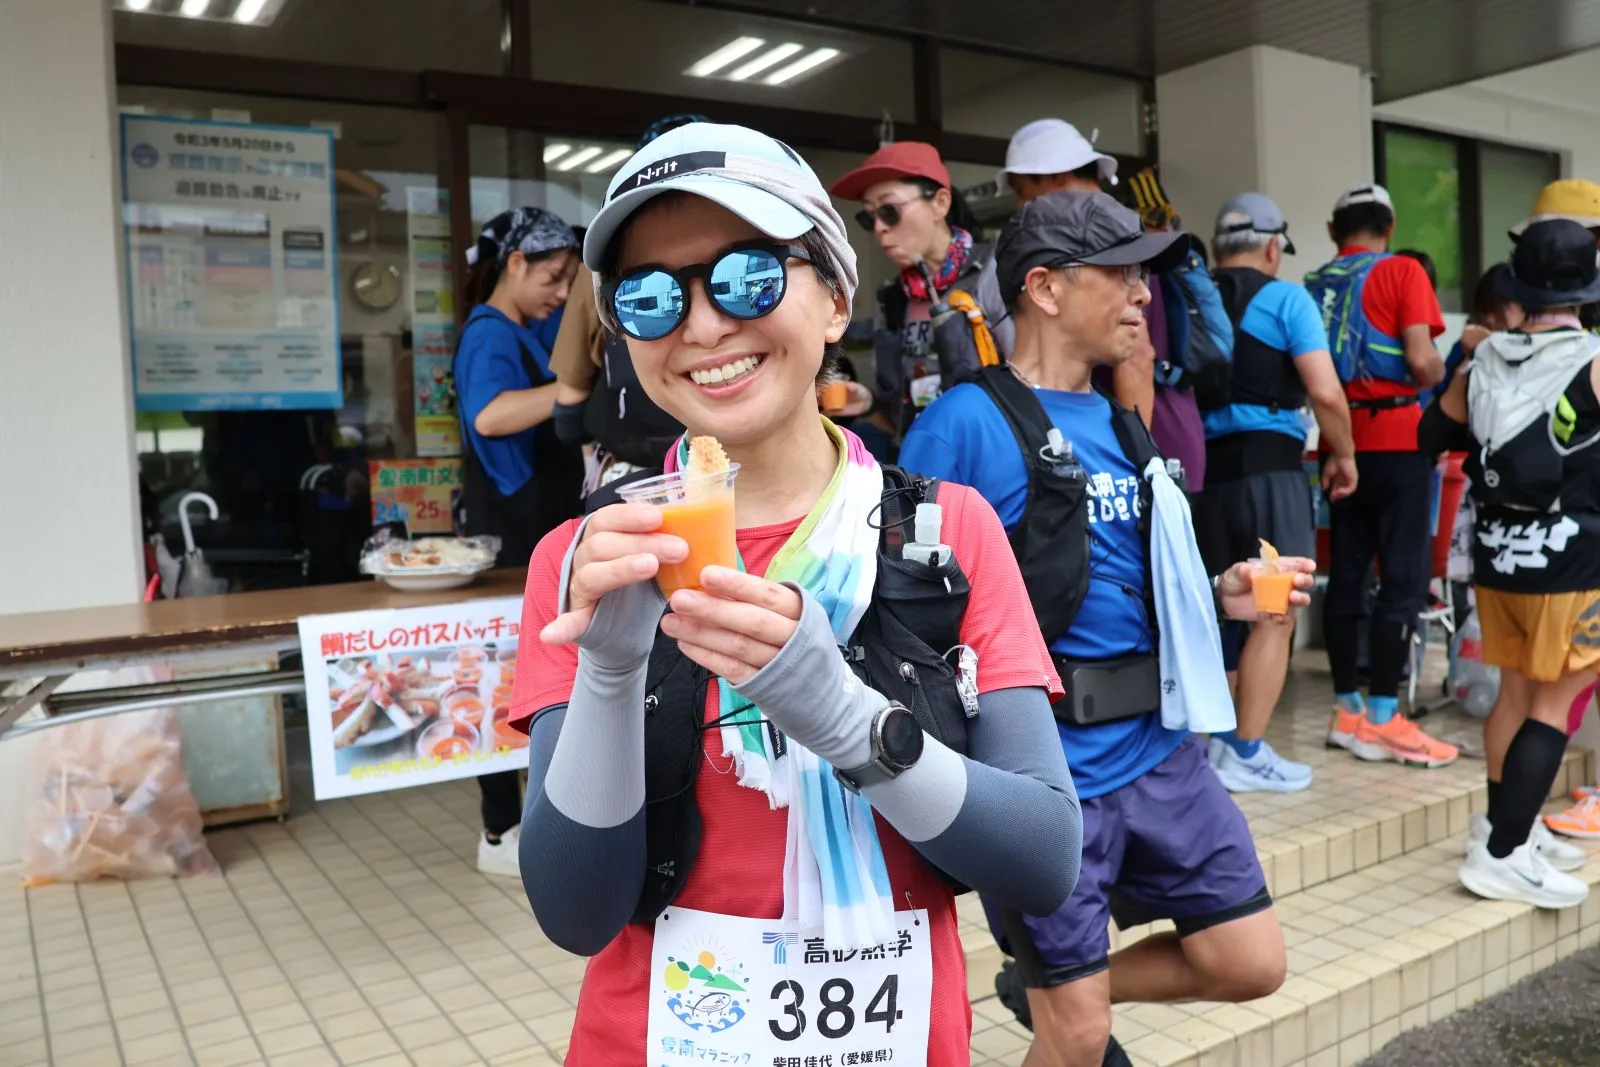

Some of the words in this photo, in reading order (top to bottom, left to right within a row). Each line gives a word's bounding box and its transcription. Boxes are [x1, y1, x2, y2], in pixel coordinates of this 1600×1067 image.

[416, 501, 440, 519] 25
[768, 974, 903, 1041] 384
[661, 1036, 751, 1066] 愛南マラニック
